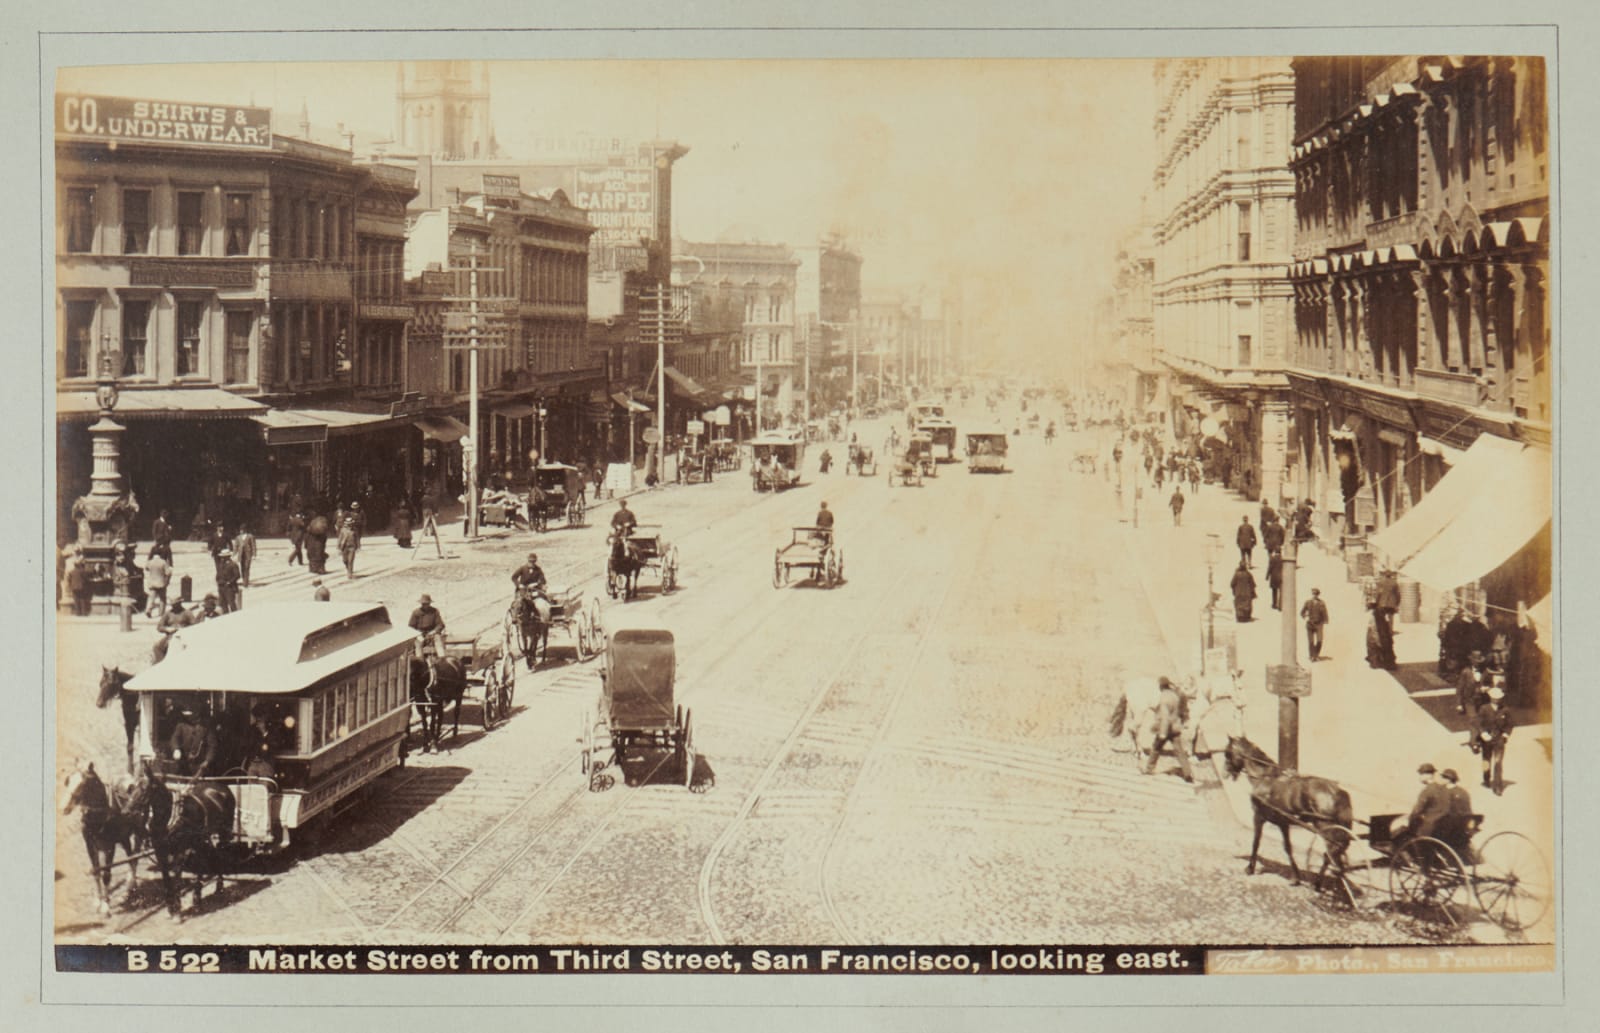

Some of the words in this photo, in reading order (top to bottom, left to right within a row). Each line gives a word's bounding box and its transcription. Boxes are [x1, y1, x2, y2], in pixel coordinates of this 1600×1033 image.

[63, 97, 105, 134] CO.
[134, 102, 226, 124] SHIRTS
[234, 109, 247, 125] &
[108, 117, 264, 144] UNDERWEAR.
[577, 192, 650, 209] CARPET
